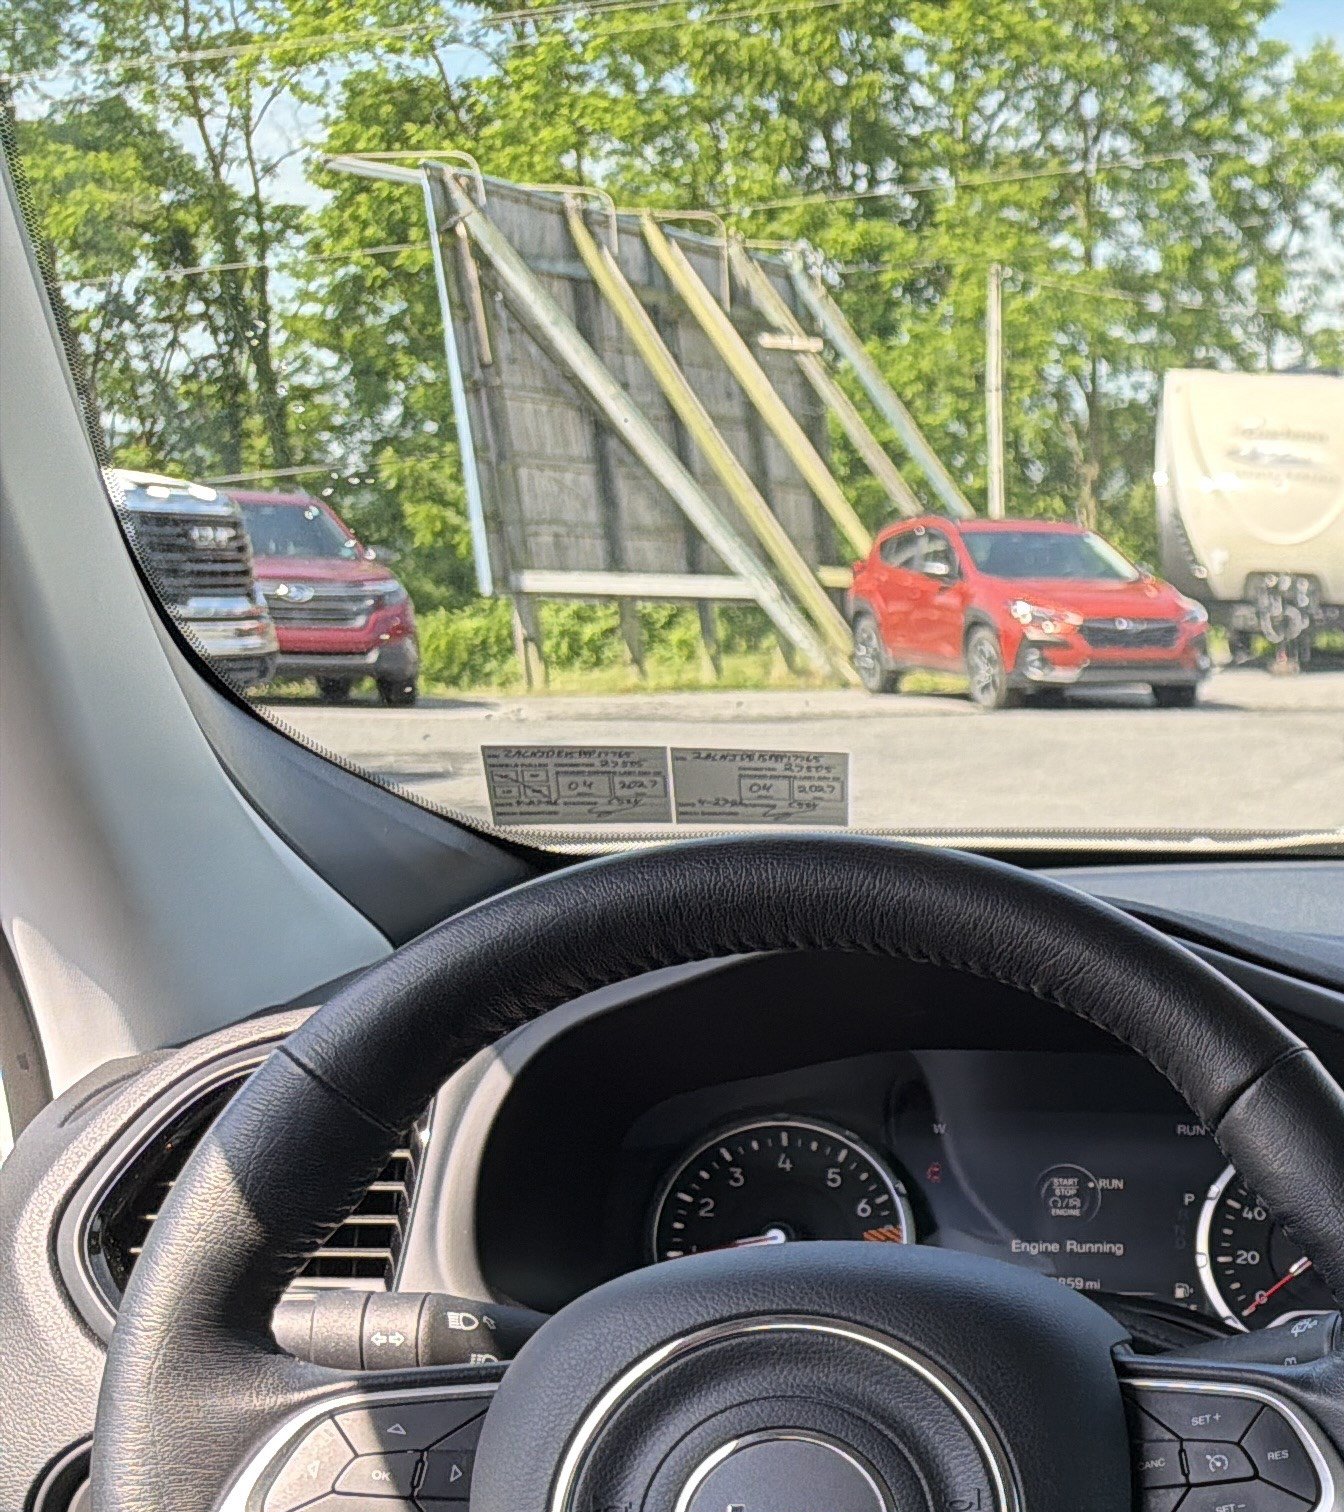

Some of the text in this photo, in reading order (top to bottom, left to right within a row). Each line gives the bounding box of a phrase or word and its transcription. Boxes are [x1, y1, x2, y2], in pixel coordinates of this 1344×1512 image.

[749, 782, 773, 793] 04
[1177, 1123, 1207, 1136] RUN
[777, 1153, 793, 1172] 4
[728, 1166, 745, 1188] 3
[826, 1167, 842, 1188] 5
[1099, 1179, 1124, 1190] RUN
[1184, 1193, 1195, 1205] P
[698, 1197, 715, 1217] 2
[856, 1198, 872, 1218] 6
[1242, 1207, 1267, 1221] 40
[1011, 1239, 1124, 1256] Engine Running
[1235, 1250, 1260, 1265] 20
[1085, 1278, 1101, 1290] mi
[1191, 1413, 1211, 1426] SET
[1267, 1449, 1289, 1461] RES
[1139, 1458, 1166, 1471] CANC
[371, 1469, 391, 1482] OK
